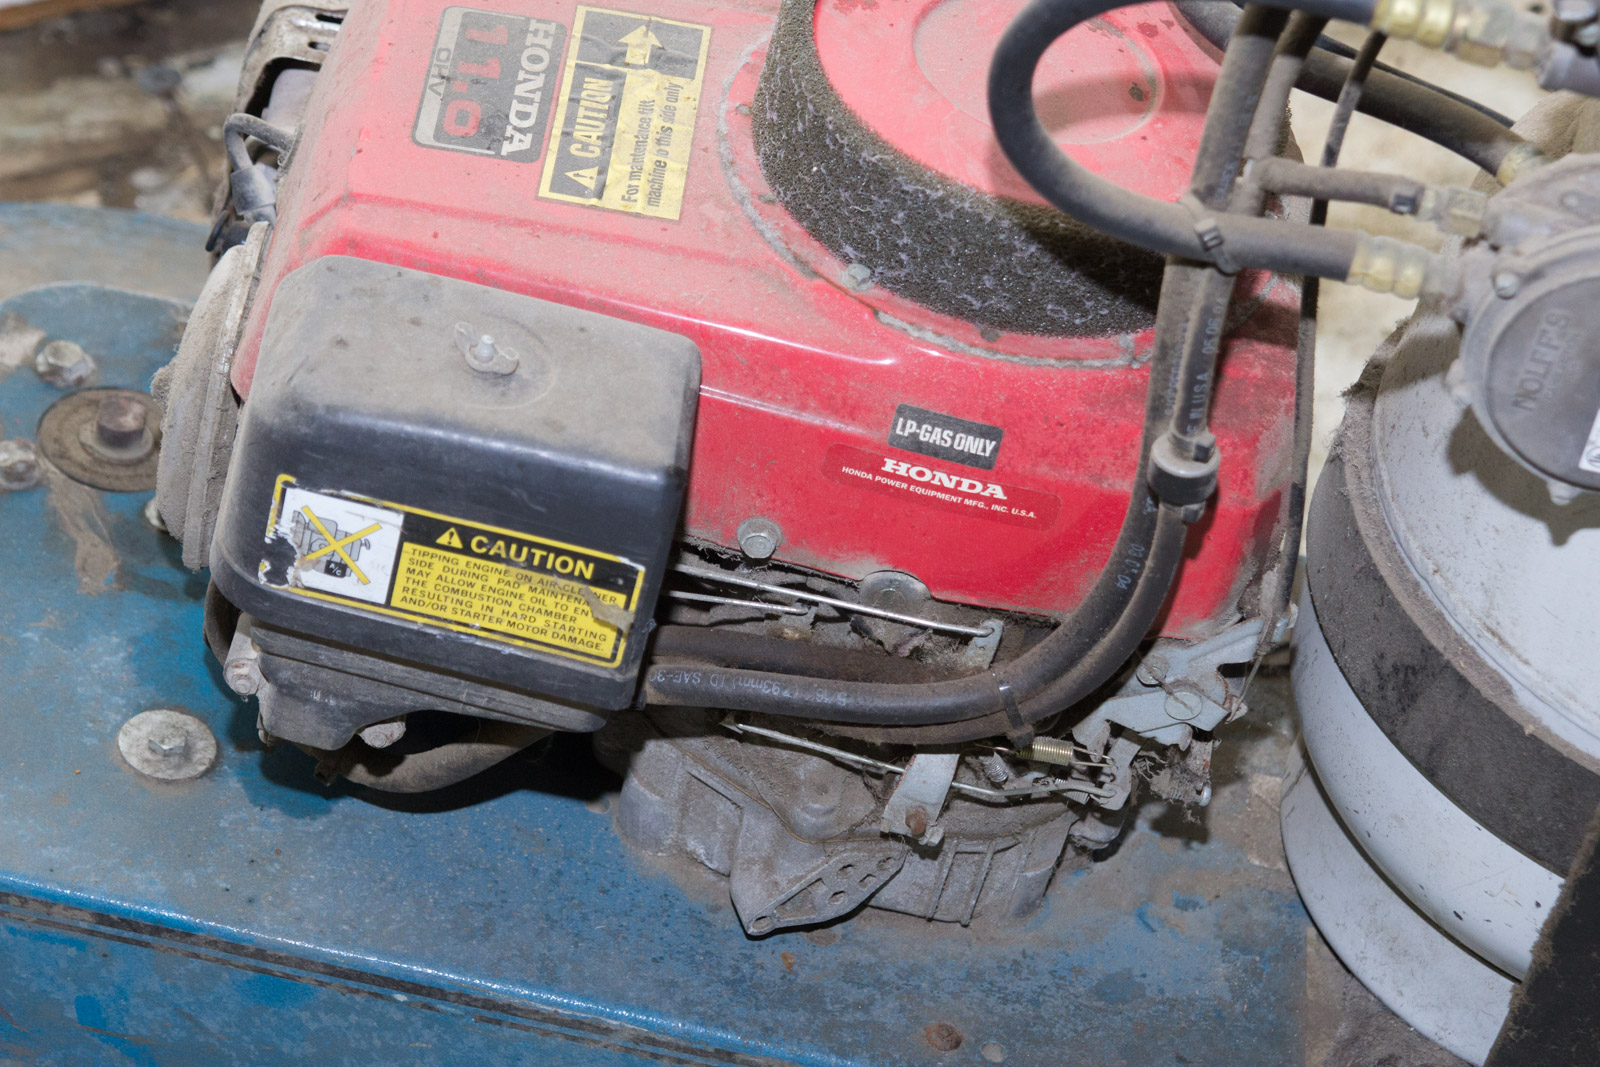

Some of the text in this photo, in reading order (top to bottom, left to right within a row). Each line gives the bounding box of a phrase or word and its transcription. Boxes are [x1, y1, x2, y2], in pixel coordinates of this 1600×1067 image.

[428, 48, 451, 98] OHV
[443, 24, 509, 137] 11.0
[501, 19, 556, 156] HONDA
[664, 83, 684, 103] only
[569, 77, 613, 158] CAUTION
[655, 125, 673, 146] this
[659, 105, 676, 124] side
[621, 184, 640, 203] For
[638, 99, 655, 115] tilt
[647, 160, 667, 207] machine
[1192, 373, 1209, 404] USA
[896, 418, 996, 457] LP-GAS ONLY
[842, 466, 873, 481] HONDA
[874, 475, 907, 490] POWER
[909, 485, 962, 504] EQUIPMENT
[991, 504, 1008, 513] INC.
[1011, 508, 1037, 519] U.S.A.
[881, 458, 1008, 500] HONDA
[328, 562, 342, 577] A/C
[412, 548, 459, 565] TIPPING
[465, 561, 510, 577] ENGINE
[515, 572, 532, 582] ON
[563, 583, 617, 603] CLENER
[470, 536, 595, 579] CAUTION
[405, 577, 428, 588] THE
[434, 584, 512, 607] COMBUSTION
[519, 603, 577, 623] CHAMBER
[406, 568, 431, 578] MAY
[436, 575, 476, 588] ALLOW
[481, 585, 525, 600] ENGINE
[530, 596, 548, 606] OIL
[554, 602, 568, 612] TO
[408, 558, 589, 606] SIDE DURING PAD MAINTENA
[400, 596, 604, 651] AND/OR STARTER MOTOR DAMAGE.
[402, 587, 607, 642] RESULTING IN HARD STARTING
